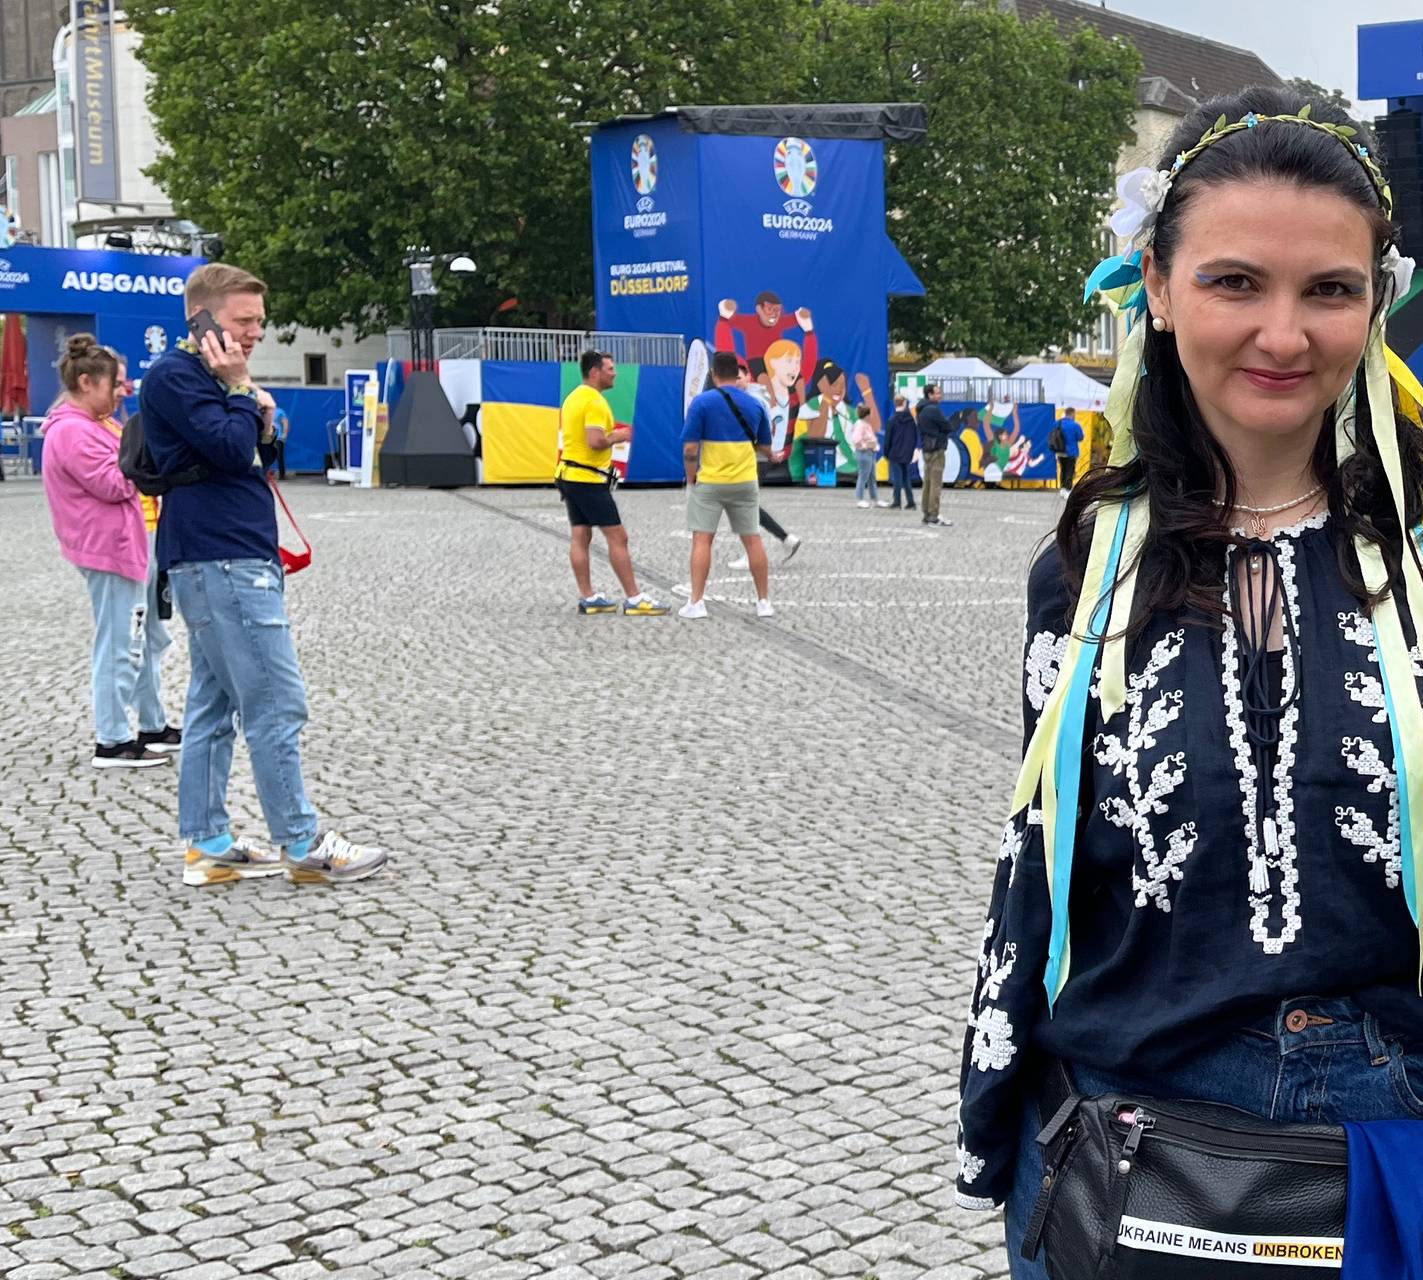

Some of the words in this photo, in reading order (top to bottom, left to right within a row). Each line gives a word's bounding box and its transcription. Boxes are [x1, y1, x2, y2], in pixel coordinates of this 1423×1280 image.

[624, 212, 667, 230] EURO2024
[762, 213, 834, 232] EURO2024
[610, 264, 631, 276] EURO
[632, 263, 651, 275] 2024
[652, 260, 688, 273] FESTIVAL
[62, 271, 185, 296] AUSGANG
[610, 275, 689, 296] DÜSSELDORF
[1188, 1236, 1247, 1255] MEANS
[1253, 1243, 1343, 1260] UNBROKEN
